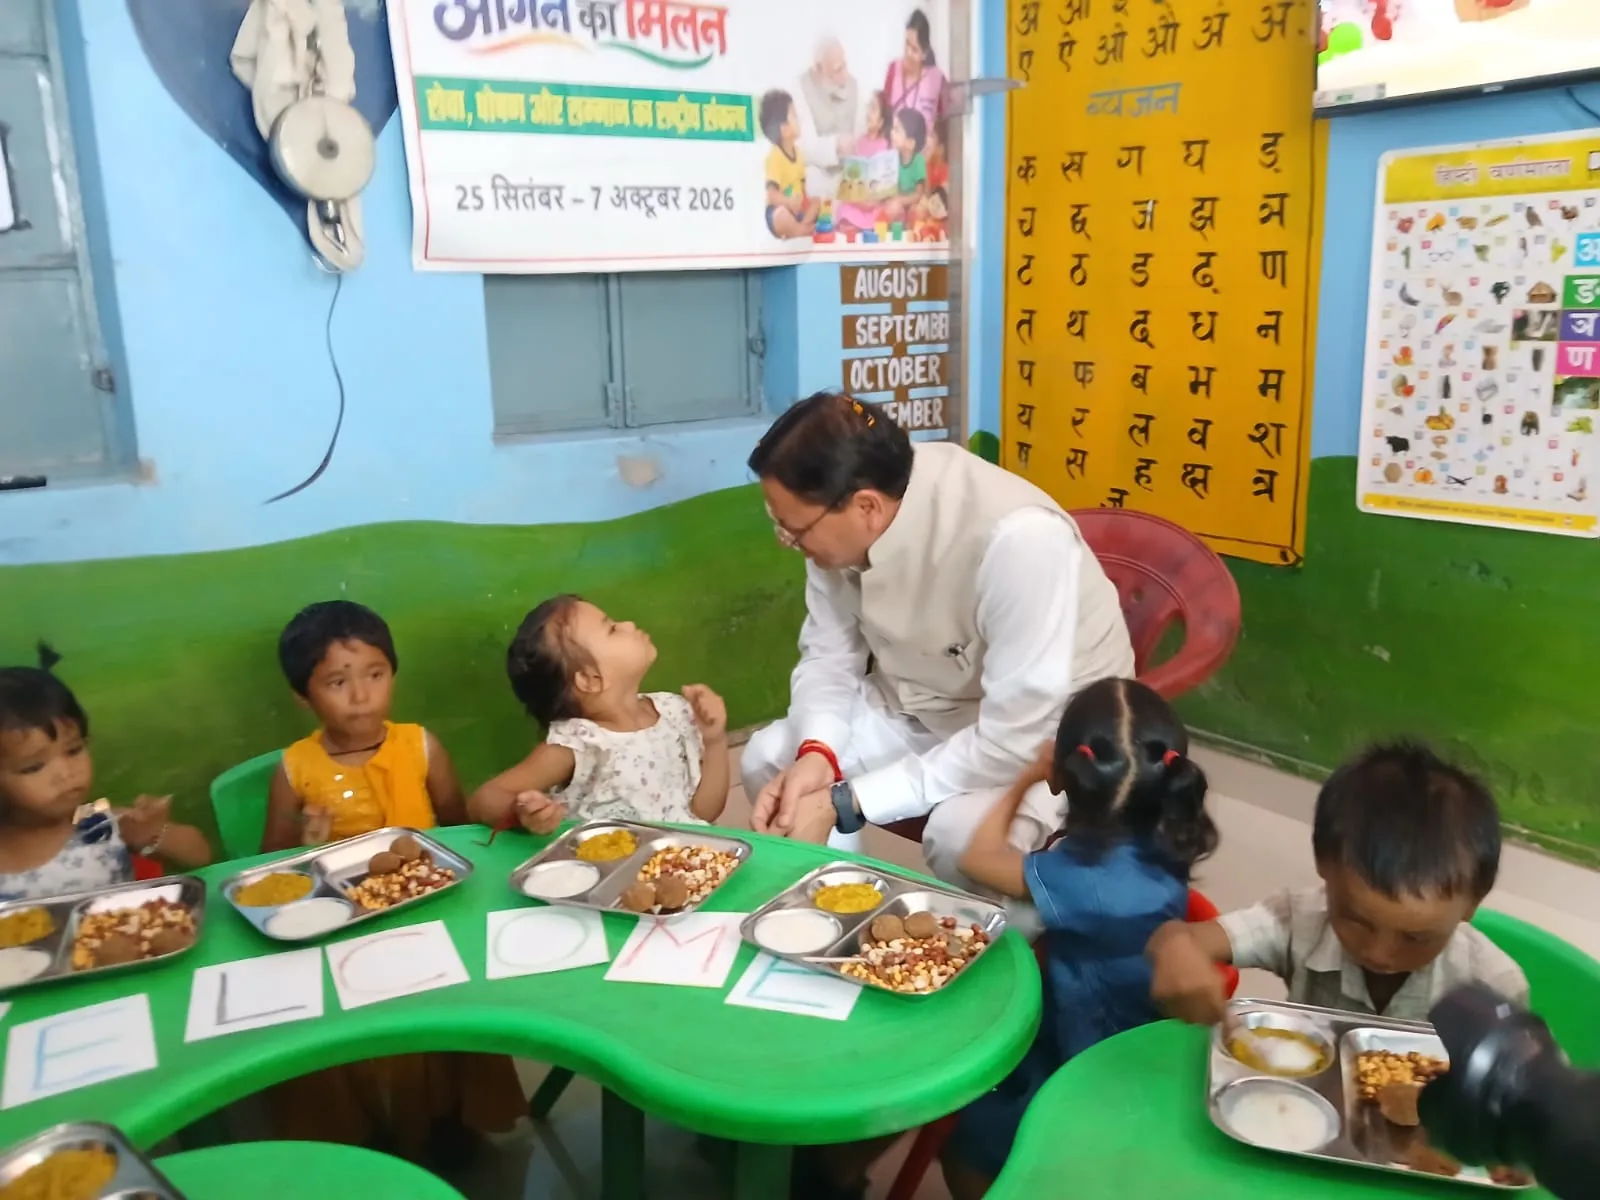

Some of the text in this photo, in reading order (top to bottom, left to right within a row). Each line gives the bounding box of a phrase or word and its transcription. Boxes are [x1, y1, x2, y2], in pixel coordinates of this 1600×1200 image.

[1018, 50, 1034, 81] ए
[1017, 155, 1037, 184] क
[1117, 145, 1146, 176] ग
[1182, 139, 1210, 174] घ
[455, 185, 485, 211] 25
[491, 173, 566, 211] सितंबर
[591, 186, 602, 211] 7
[609, 185, 682, 219] अक्टूबर
[688, 187, 736, 211] 2026
[1017, 206, 1037, 237] च
[1070, 203, 1092, 241] छ
[1132, 199, 1158, 231] ज
[854, 267, 931, 299] AUGUST
[1017, 254, 1036, 286] ट
[1070, 252, 1090, 286] ठ
[1130, 252, 1154, 288] ड
[1259, 250, 1288, 289] ण
[855, 312, 949, 346] SEPTEMBE
[1016, 309, 1037, 345] त
[1066, 309, 1089, 342] थ
[1189, 311, 1218, 344] ध
[1256, 310, 1284, 345] न
[850, 354, 941, 391] OCTOBER
[1565, 346, 1597, 371] ण
[1017, 360, 1285, 402] प फ ब भ म
[882, 398, 943, 429] EMBER
[1017, 403, 1287, 459] य र ल व श
[1065, 448, 1088, 480] स
[1134, 458, 1158, 492] ह
[1181, 463, 1213, 500] क्ष
[1252, 469, 1279, 502] त्र
[30, 1005, 130, 1092] E
[215, 971, 309, 1026] L
[338, 930, 449, 995] C
[493, 910, 593, 968] O
[619, 912, 728, 974] M
